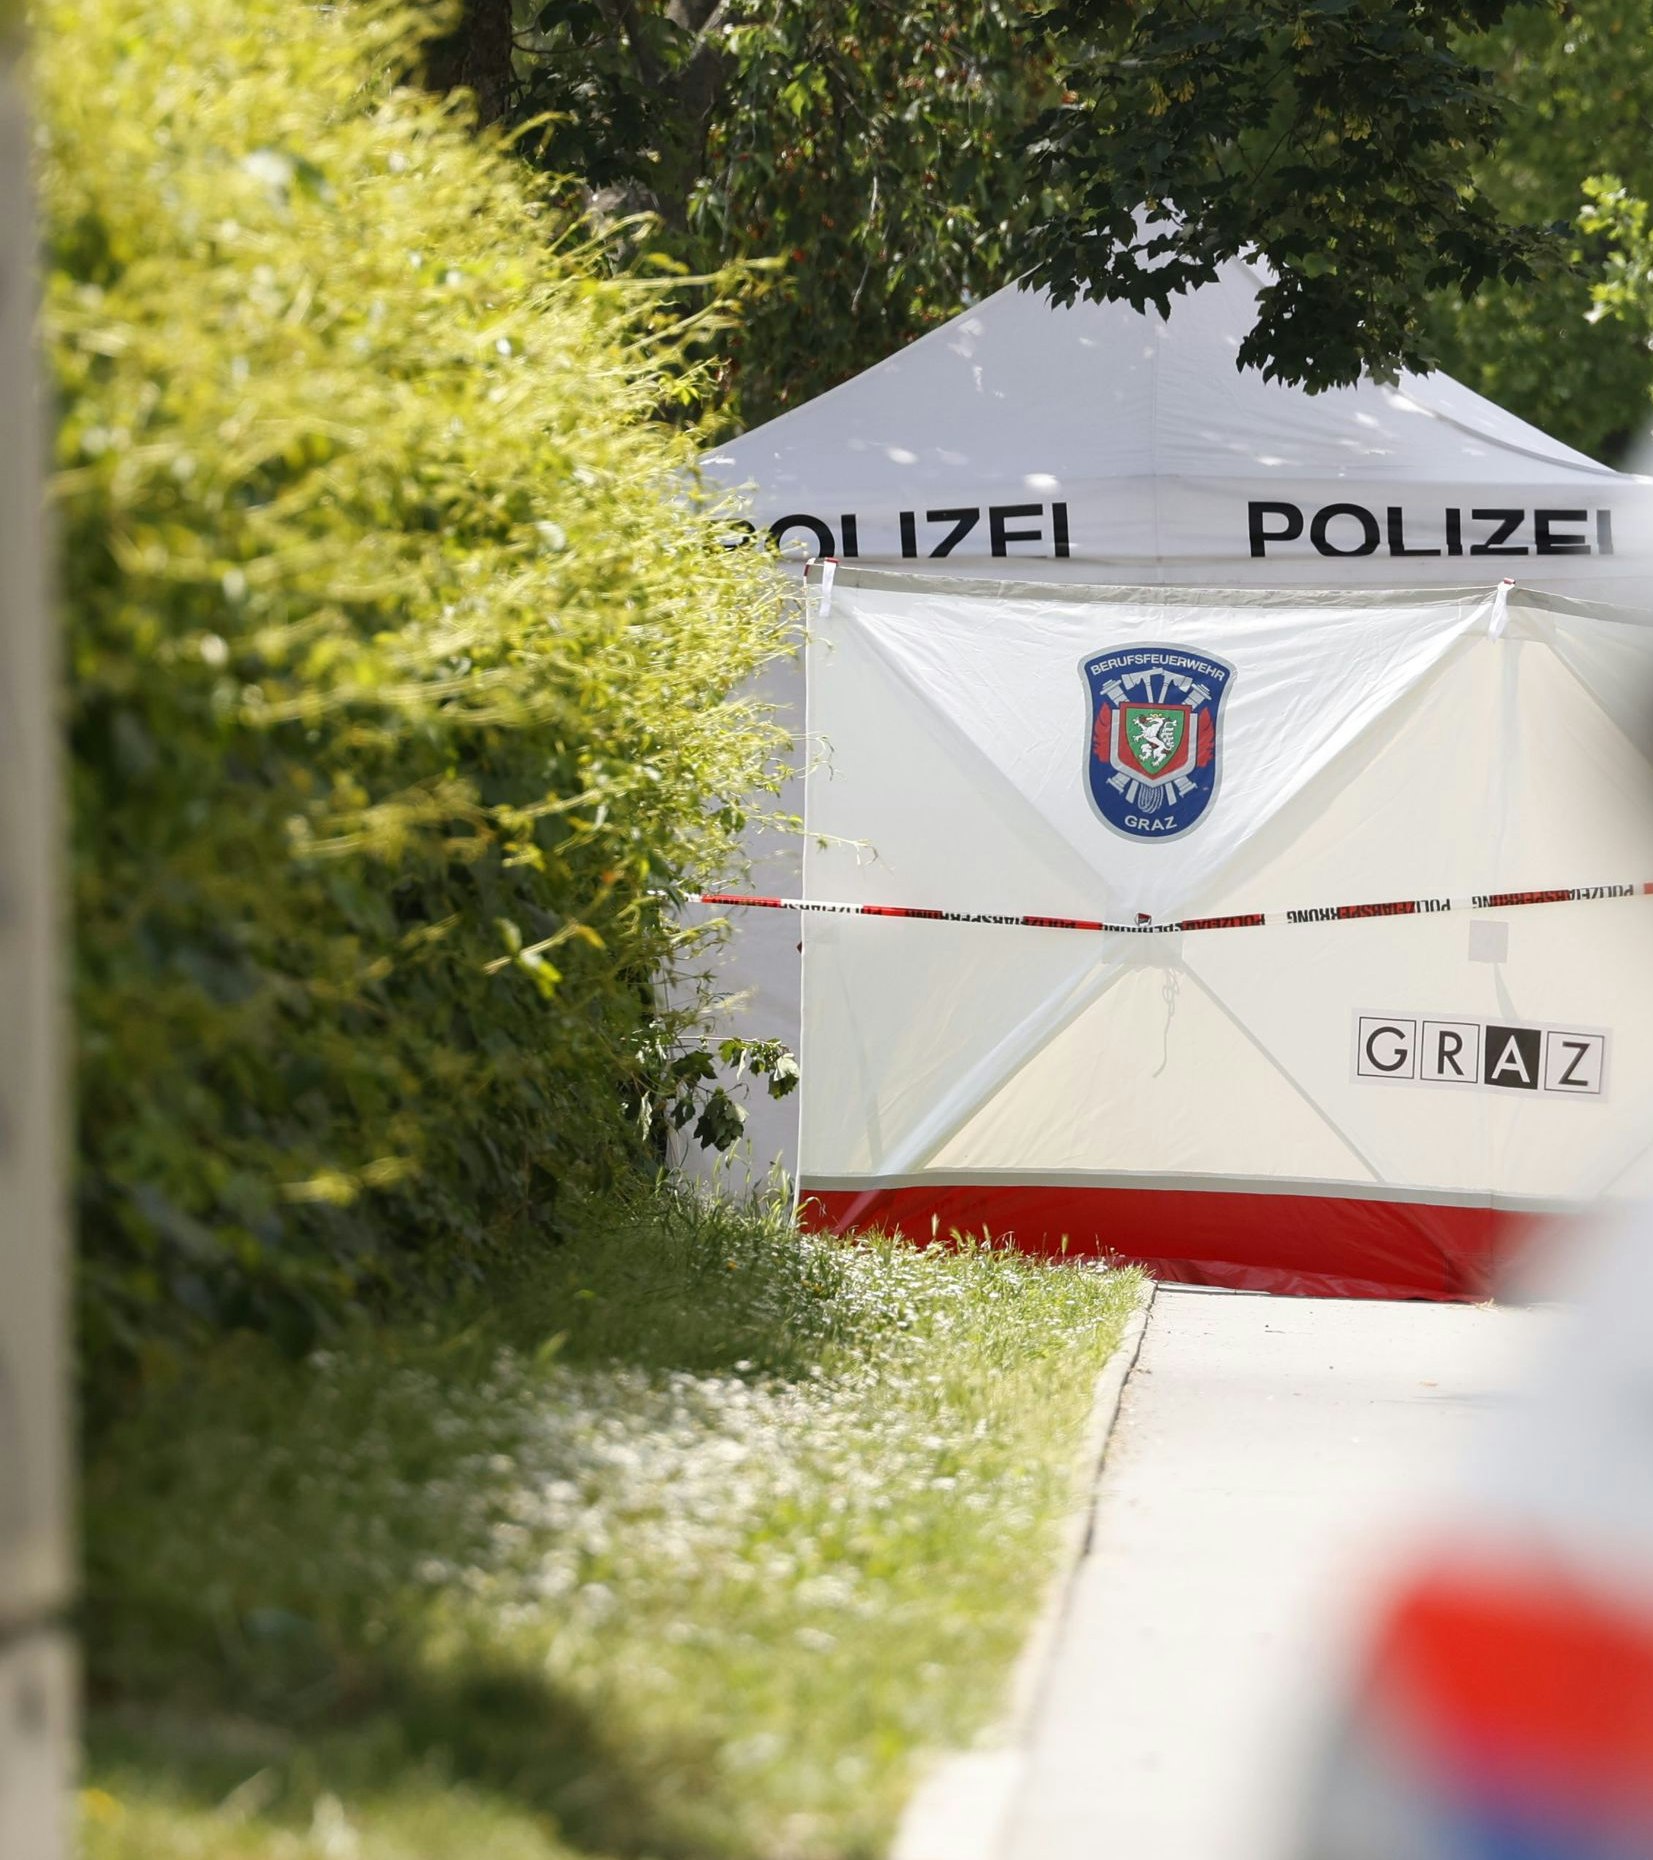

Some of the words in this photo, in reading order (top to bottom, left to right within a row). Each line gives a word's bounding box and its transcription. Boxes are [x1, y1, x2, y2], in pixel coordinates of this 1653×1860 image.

[1248, 501, 1614, 558] POLIZEI
[1090, 653, 1226, 682] BERUFSFEUERWEHR
[1124, 814, 1177, 831] GRAZ
[1366, 1026, 1592, 1087] GRAZ
